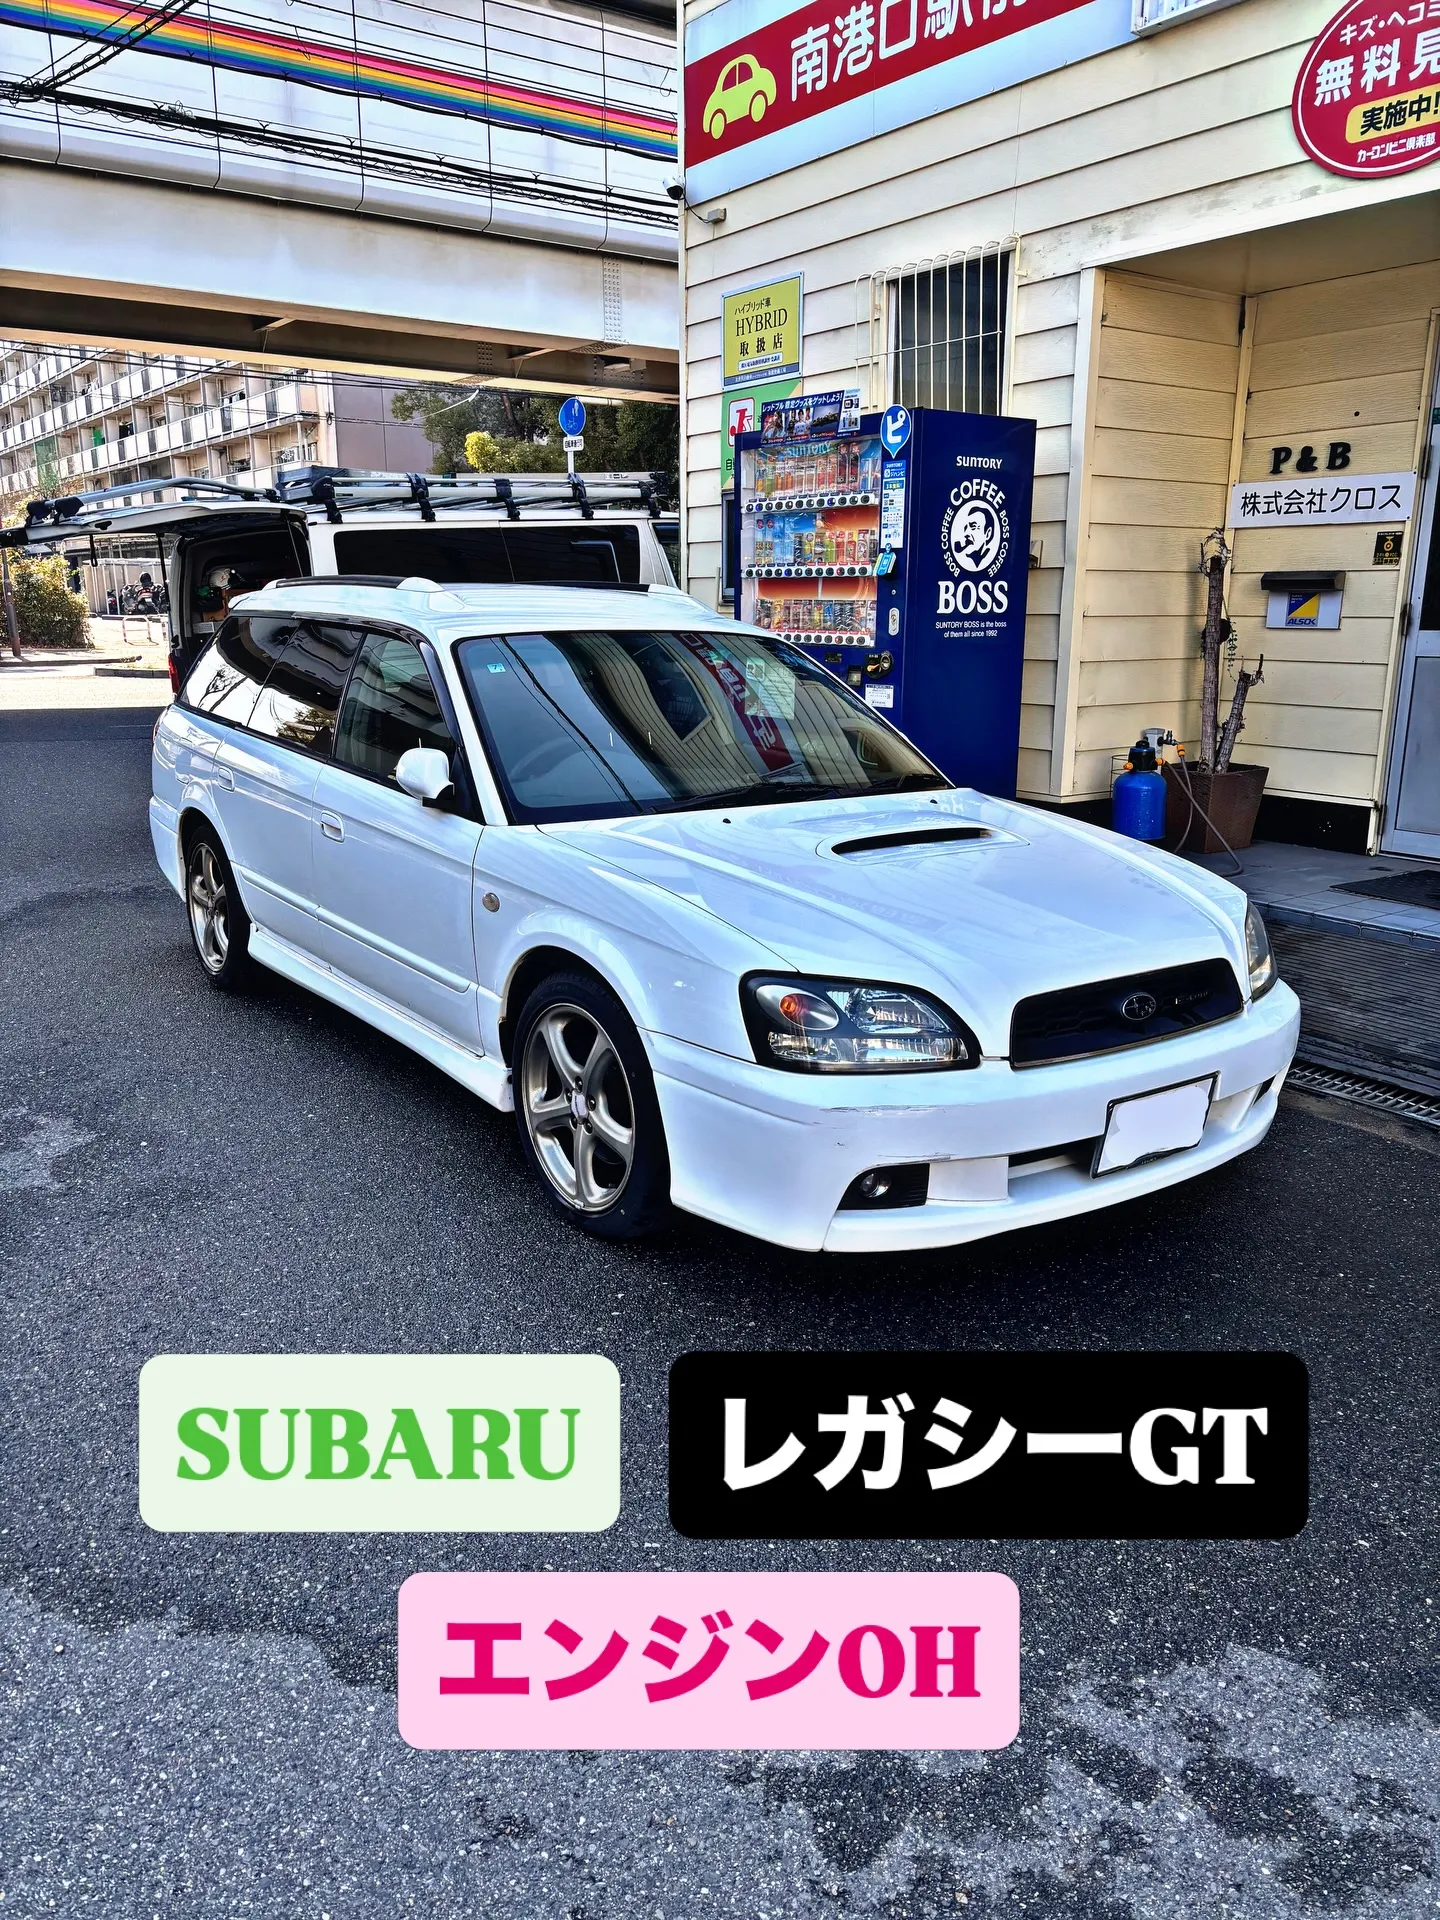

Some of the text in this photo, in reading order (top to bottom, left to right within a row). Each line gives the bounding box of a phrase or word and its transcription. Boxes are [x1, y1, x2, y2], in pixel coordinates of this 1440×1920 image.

[734, 297, 772, 316] ハイブリッド車
[735, 308, 788, 337] HYBRID
[739, 332, 783, 357] 取扱店
[956, 455, 1003, 470] SUNTORY
[1269, 442, 1351, 475] P & B
[950, 478, 1006, 510] COFFEE
[1240, 485, 1401, 517] 株式会社クロス
[941, 506, 961, 578] BOSS COFFEE
[987, 509, 1010, 578] BOSS COFFEE
[936, 580, 1009, 614] BOSS
[935, 621, 963, 629] SUNTORY
[963, 620, 980, 628] BOSS
[950, 630, 963, 638] them
[985, 629, 998, 637] 1992
[1287, 618, 1317, 626] ALSOK
